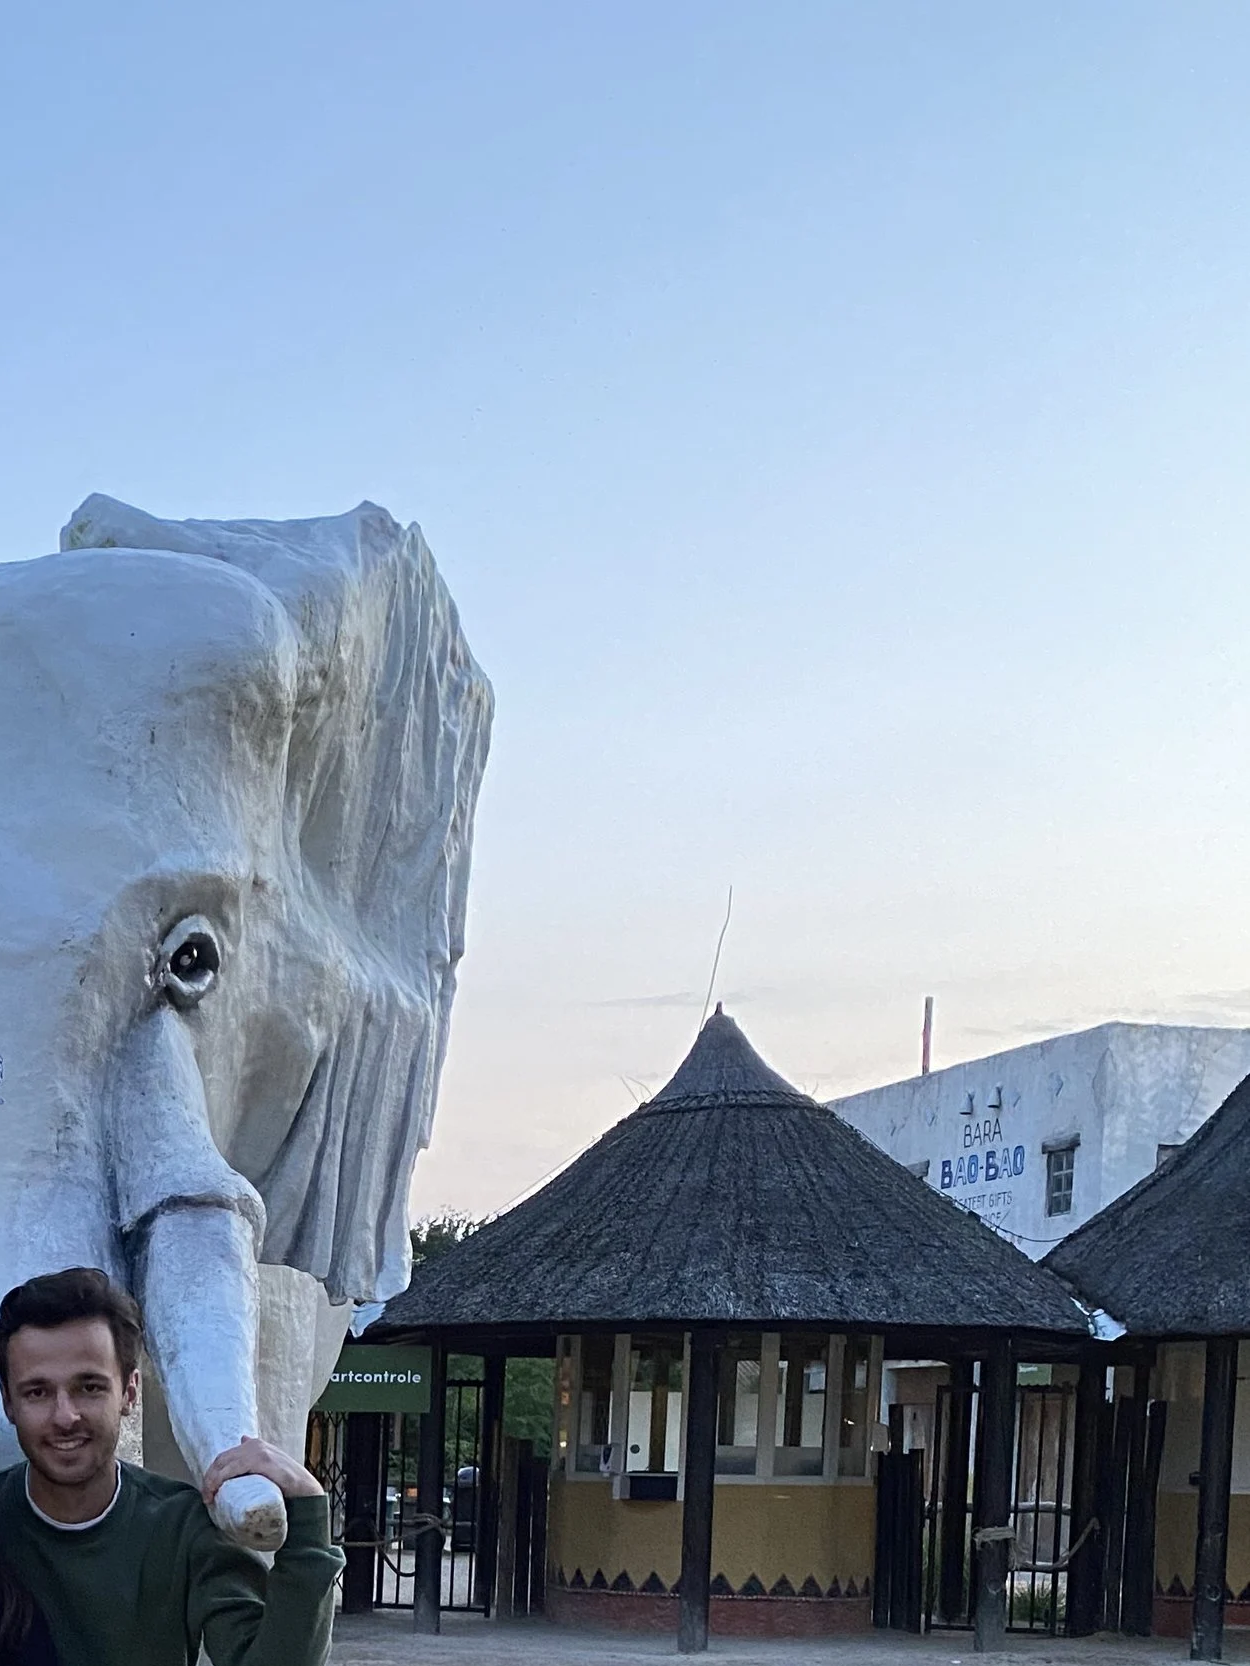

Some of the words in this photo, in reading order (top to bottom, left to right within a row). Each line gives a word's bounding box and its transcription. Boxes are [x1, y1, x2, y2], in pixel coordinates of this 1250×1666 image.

[963, 1118, 1002, 1148] BARA
[941, 1145, 1025, 1189] BAO-BAO
[989, 1190, 1012, 1207] GIFTS
[331, 1370, 421, 1383] artcontrole
